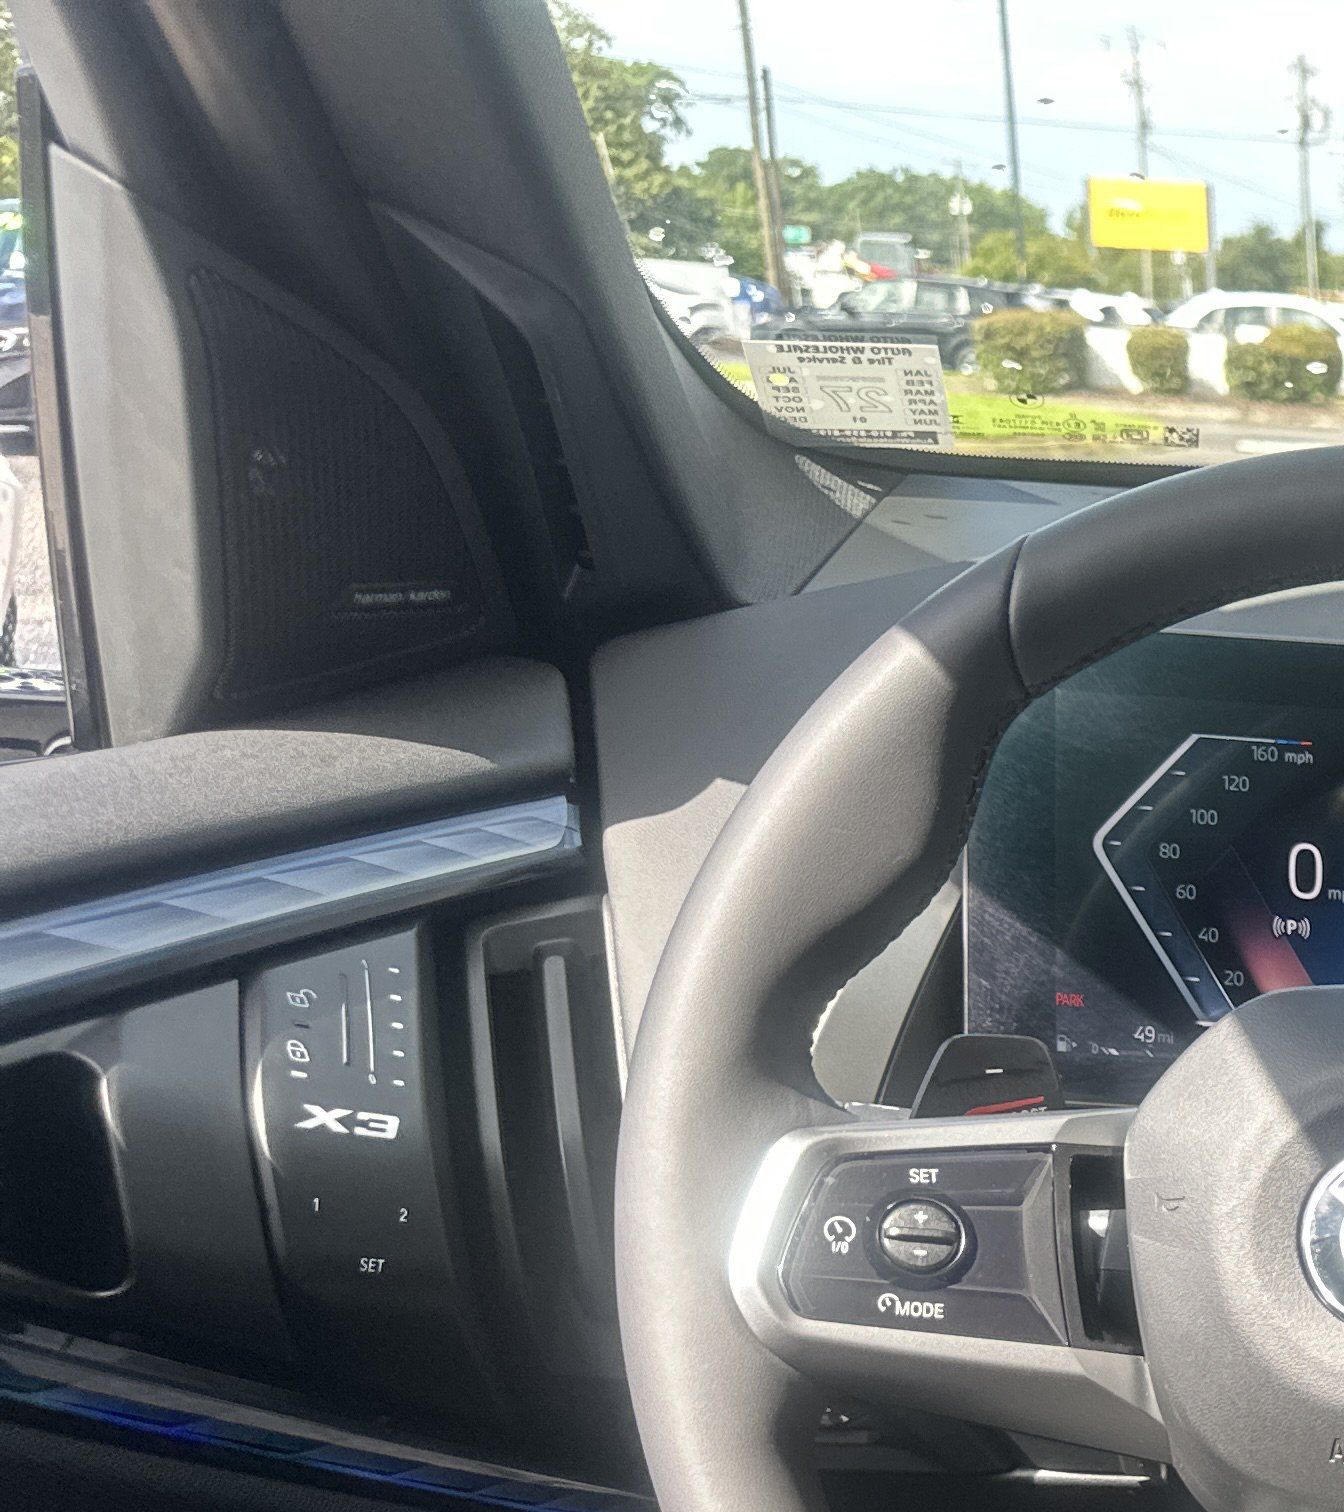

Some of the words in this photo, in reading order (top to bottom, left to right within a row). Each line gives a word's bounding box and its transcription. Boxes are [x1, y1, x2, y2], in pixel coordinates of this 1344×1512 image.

[1251, 745, 1278, 762] 160
[1285, 750, 1314, 765] mph
[1222, 775, 1250, 792] 120
[1190, 808, 1218, 826] 100
[1159, 843, 1181, 859] 80
[1288, 842, 1323, 900] 0
[1175, 884, 1197, 900] 60
[1198, 927, 1219, 943] 40
[1223, 970, 1244, 987] 20
[1055, 992, 1085, 1007] PARK
[1133, 1025, 1156, 1043] 49
[1157, 1031, 1174, 1044] mi
[294, 1104, 400, 1139] X3
[909, 1168, 939, 1184] SET
[313, 1197, 319, 1212] 1
[399, 1208, 408, 1222] 2
[359, 1257, 386, 1273] SET
[895, 1302, 945, 1319] MODE
